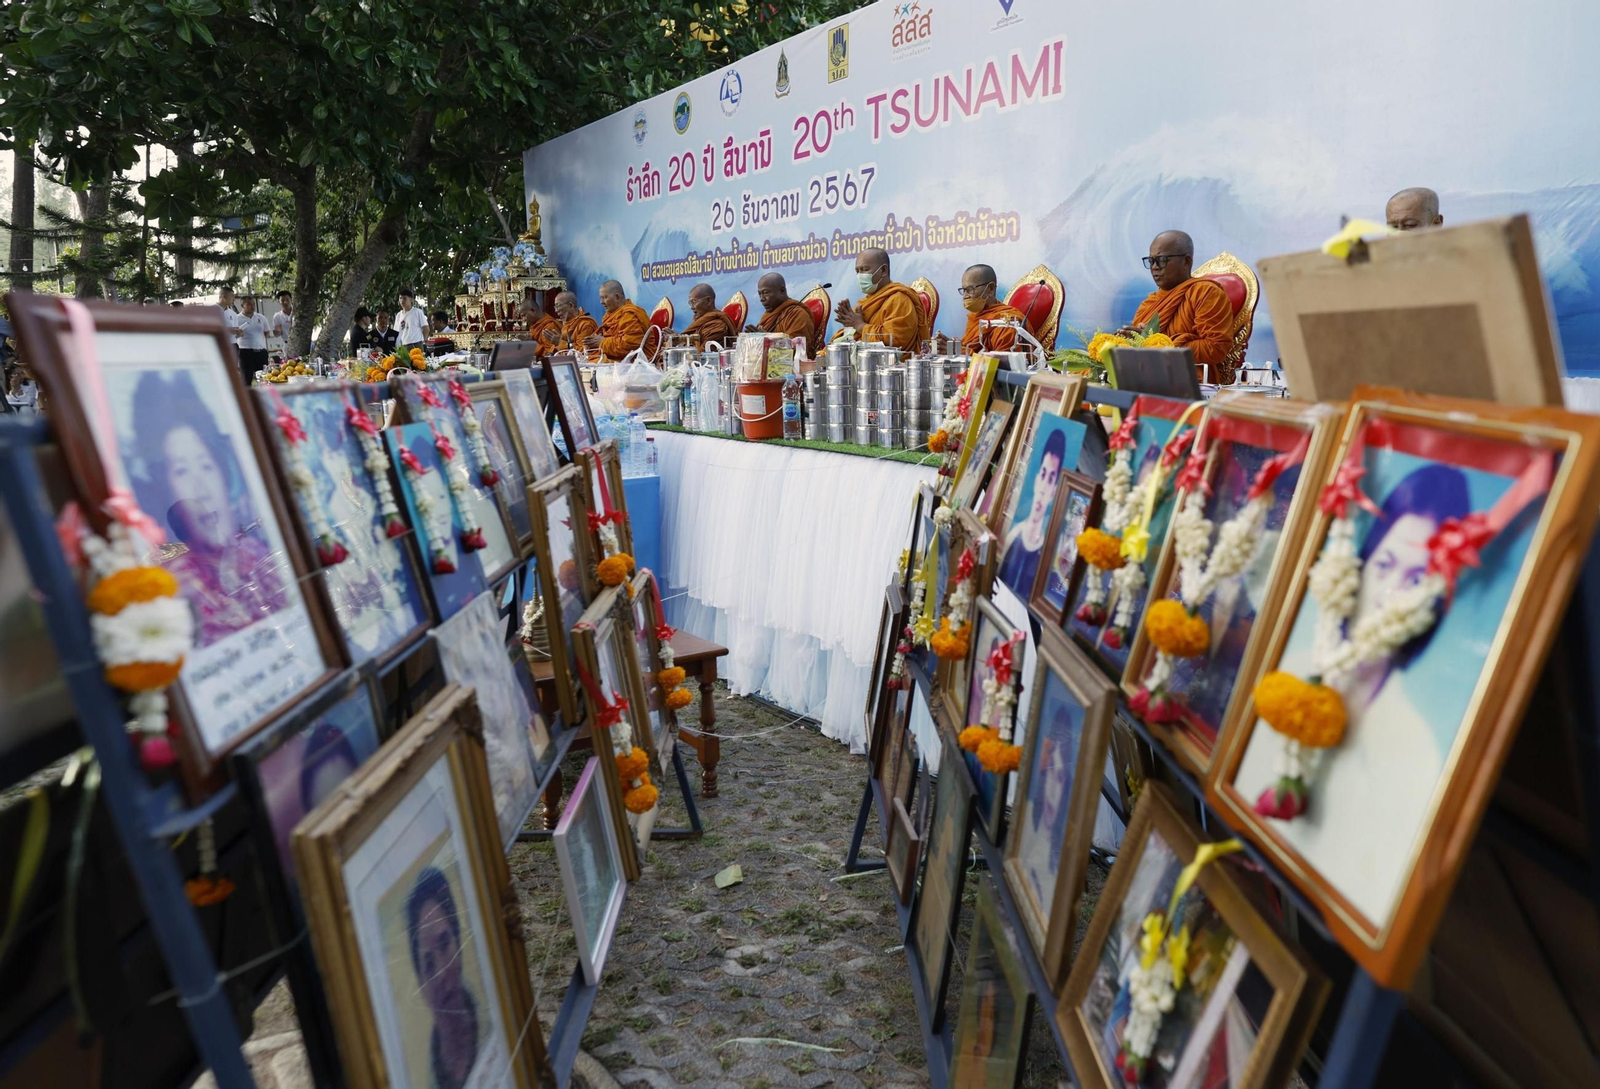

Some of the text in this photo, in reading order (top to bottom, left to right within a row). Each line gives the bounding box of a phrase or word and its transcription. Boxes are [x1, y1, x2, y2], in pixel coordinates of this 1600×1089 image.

[892, 8, 933, 48] สสส
[626, 161, 661, 202] รำลึก
[669, 152, 695, 192] 20
[703, 143, 715, 182] ปี
[723, 129, 772, 177] สึนามิ
[793, 101, 854, 161] 20th
[866, 40, 1063, 140] TSUNAMI
[712, 167, 875, 231] 26 ธันวาคม 2567
[641, 266, 650, 280] ณ
[715, 241, 760, 272] บ้านน้ำเค็ม
[762, 236, 828, 266] ตำบลบางม่วง
[927, 212, 1018, 247] จังหวัดพังงา
